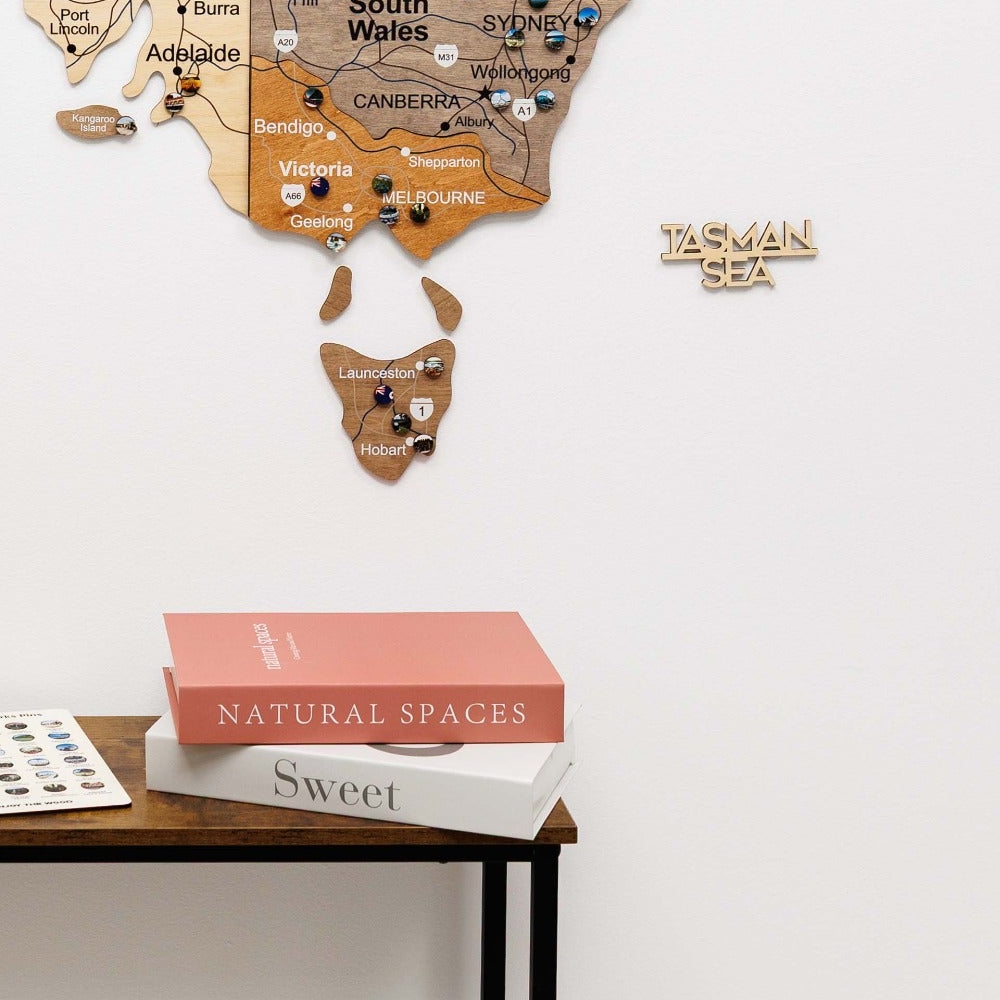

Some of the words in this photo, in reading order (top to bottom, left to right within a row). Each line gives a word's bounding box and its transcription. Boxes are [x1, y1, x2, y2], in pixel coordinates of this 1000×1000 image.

[61, 9, 89, 21] Port
[194, 2, 239, 15] Burra
[50, 23, 99, 34] Lincoln
[348, 20, 428, 41] Wales
[483, 16, 572, 31] SYDNEY
[146, 44, 240, 61] Adelaide
[471, 65, 570, 82] Wollongong
[354, 94, 460, 109] CANBERRA
[72, 114, 115, 125] Kangaroo
[455, 116, 493, 129] Albury
[81, 124, 106, 132] Island
[254, 119, 323, 137] Bendigo
[279, 161, 352, 176] Victoria
[409, 157, 480, 170] Shepparton
[286, 192, 301, 200] A66
[383, 192, 485, 204] MELBOURNE
[291, 215, 352, 231] Geelong
[661, 220, 813, 257] TASMAN
[701, 256, 775, 288] SEA
[339, 368, 415, 378] Launceston
[361, 444, 406, 455] Hobart
[218, 703, 385, 725] NATURAL
[400, 701, 526, 725] SPACES
[274, 759, 400, 811] Sweet
